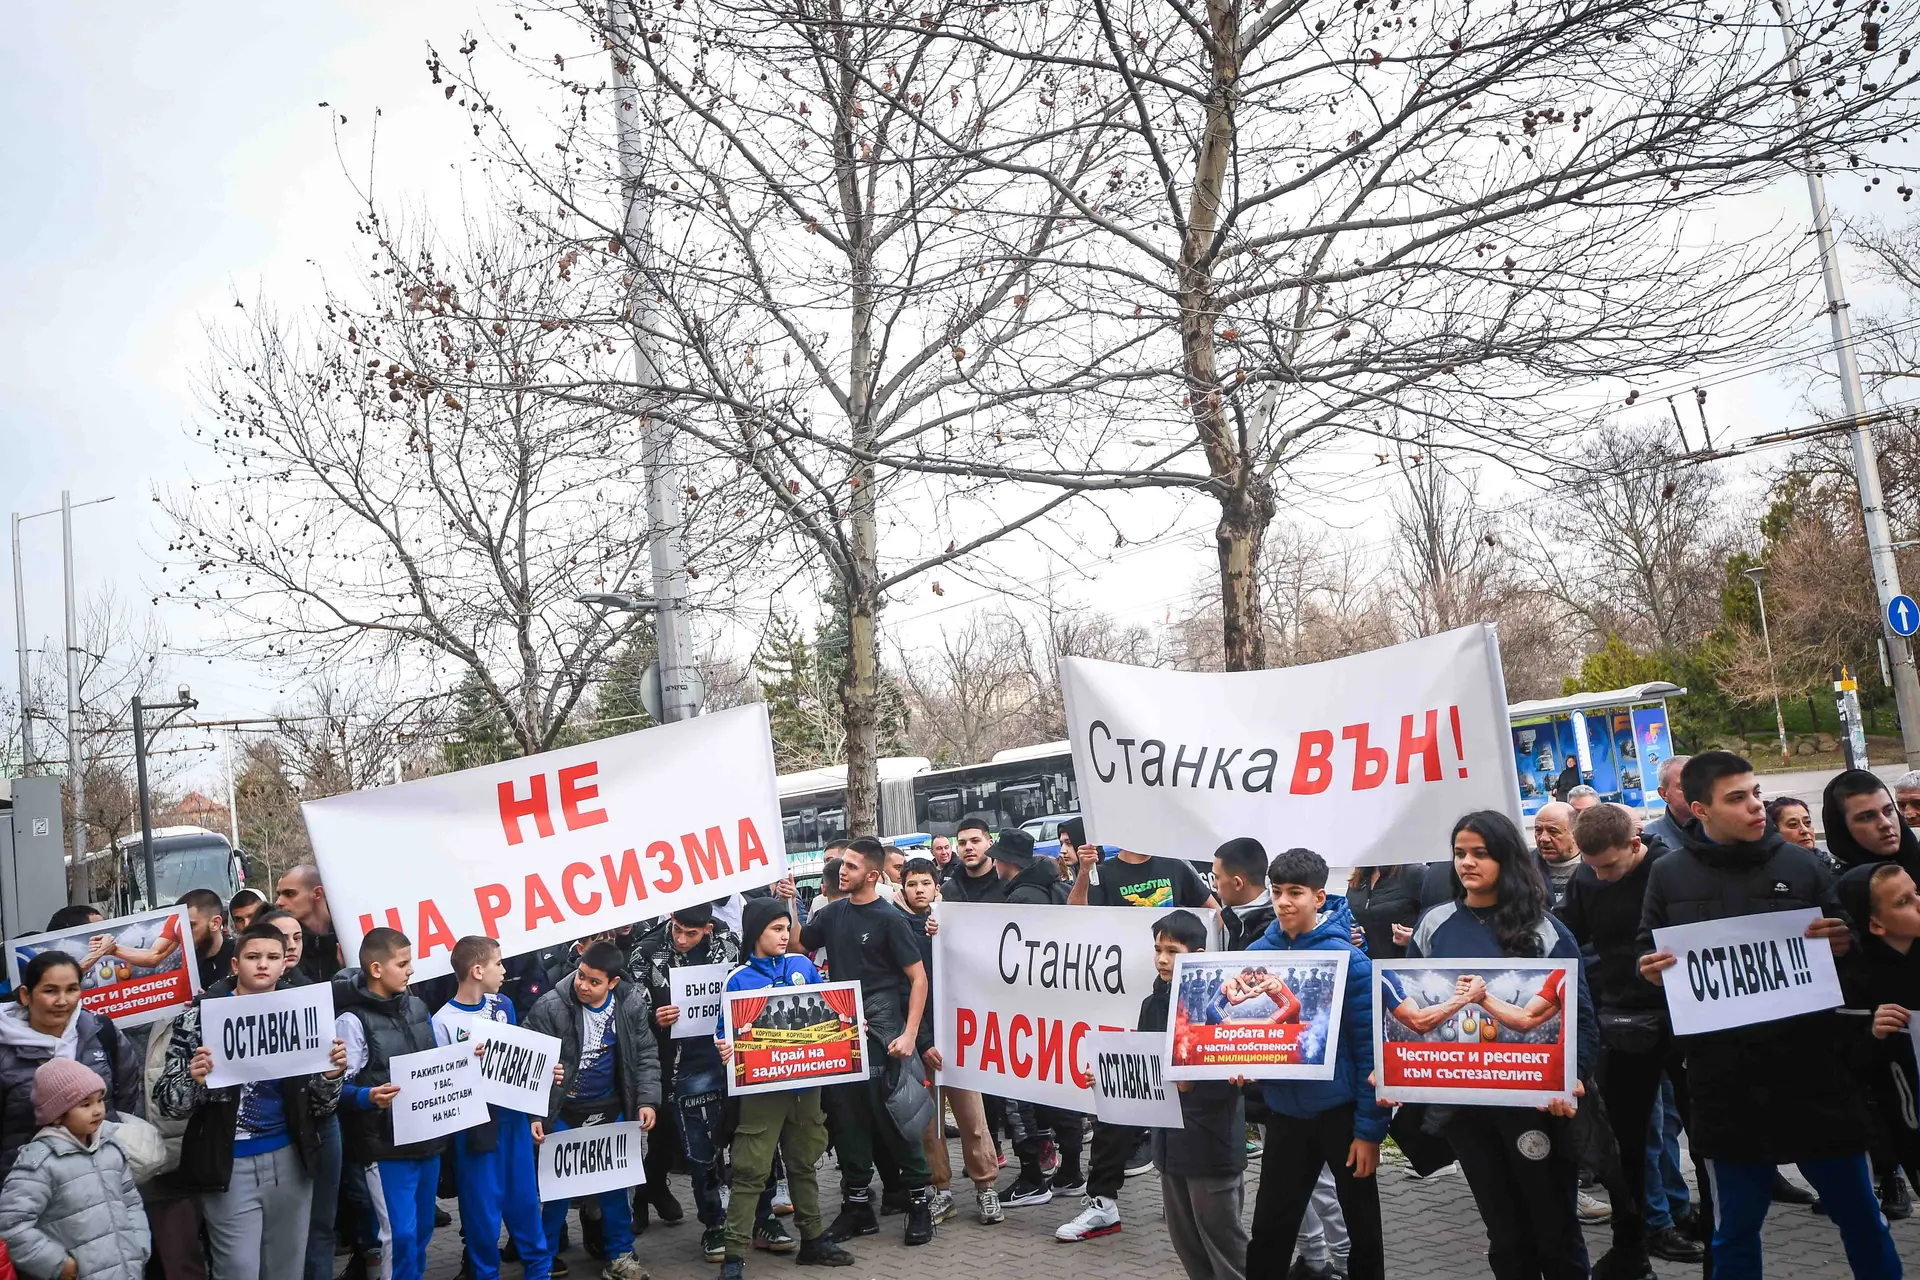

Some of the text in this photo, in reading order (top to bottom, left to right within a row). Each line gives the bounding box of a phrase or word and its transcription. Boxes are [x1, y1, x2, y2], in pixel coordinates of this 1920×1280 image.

[1089, 705, 1468, 796] Станка ВЪН!
[497, 761, 608, 846] НЕ
[474, 817, 769, 939] РАСИЗМА
[998, 921, 1126, 995] Станка
[1687, 937, 1812, 1002] ОСТАВКА !!!
[109, 989, 119, 1000] и
[122, 976, 179, 999] респект
[685, 983, 706, 997] ВЪН
[687, 1005, 700, 1019] ОТ
[223, 1006, 319, 1061] ОСТАВКА !!!
[755, 1030, 782, 1038] КОРУПЦИЯ
[786, 1031, 813, 1039] КОРУПЦИЯ
[1214, 1027, 1285, 1041] Борбата не
[734, 1042, 762, 1050] КОРУПЦИЯ
[771, 1047, 825, 1063] Край на
[956, 1007, 1138, 1090] РАСИС
[1204, 1043, 1236, 1053] частна
[1236, 1041, 1298, 1051] собственост
[1396, 1047, 1550, 1066] Честност и респект
[411, 1057, 469, 1079] РАКИЯТА СИ ПИЙ
[480, 1038, 547, 1091] ОСТАВКА !!!
[752, 1058, 847, 1078] задкулисието
[1203, 1052, 1288, 1063] на милиционери
[433, 1078, 454, 1090] У ВАС,
[1098, 1052, 1165, 1100] ОСТАВКА !!!
[1403, 1067, 1543, 1081] към състезателите
[411, 1087, 473, 1111] БОРБАТА ОСТАВИ
[432, 1112, 443, 1122] НА
[443, 1107, 457, 1119] НАС
[554, 1133, 628, 1178] ОСТАВКА !!!
